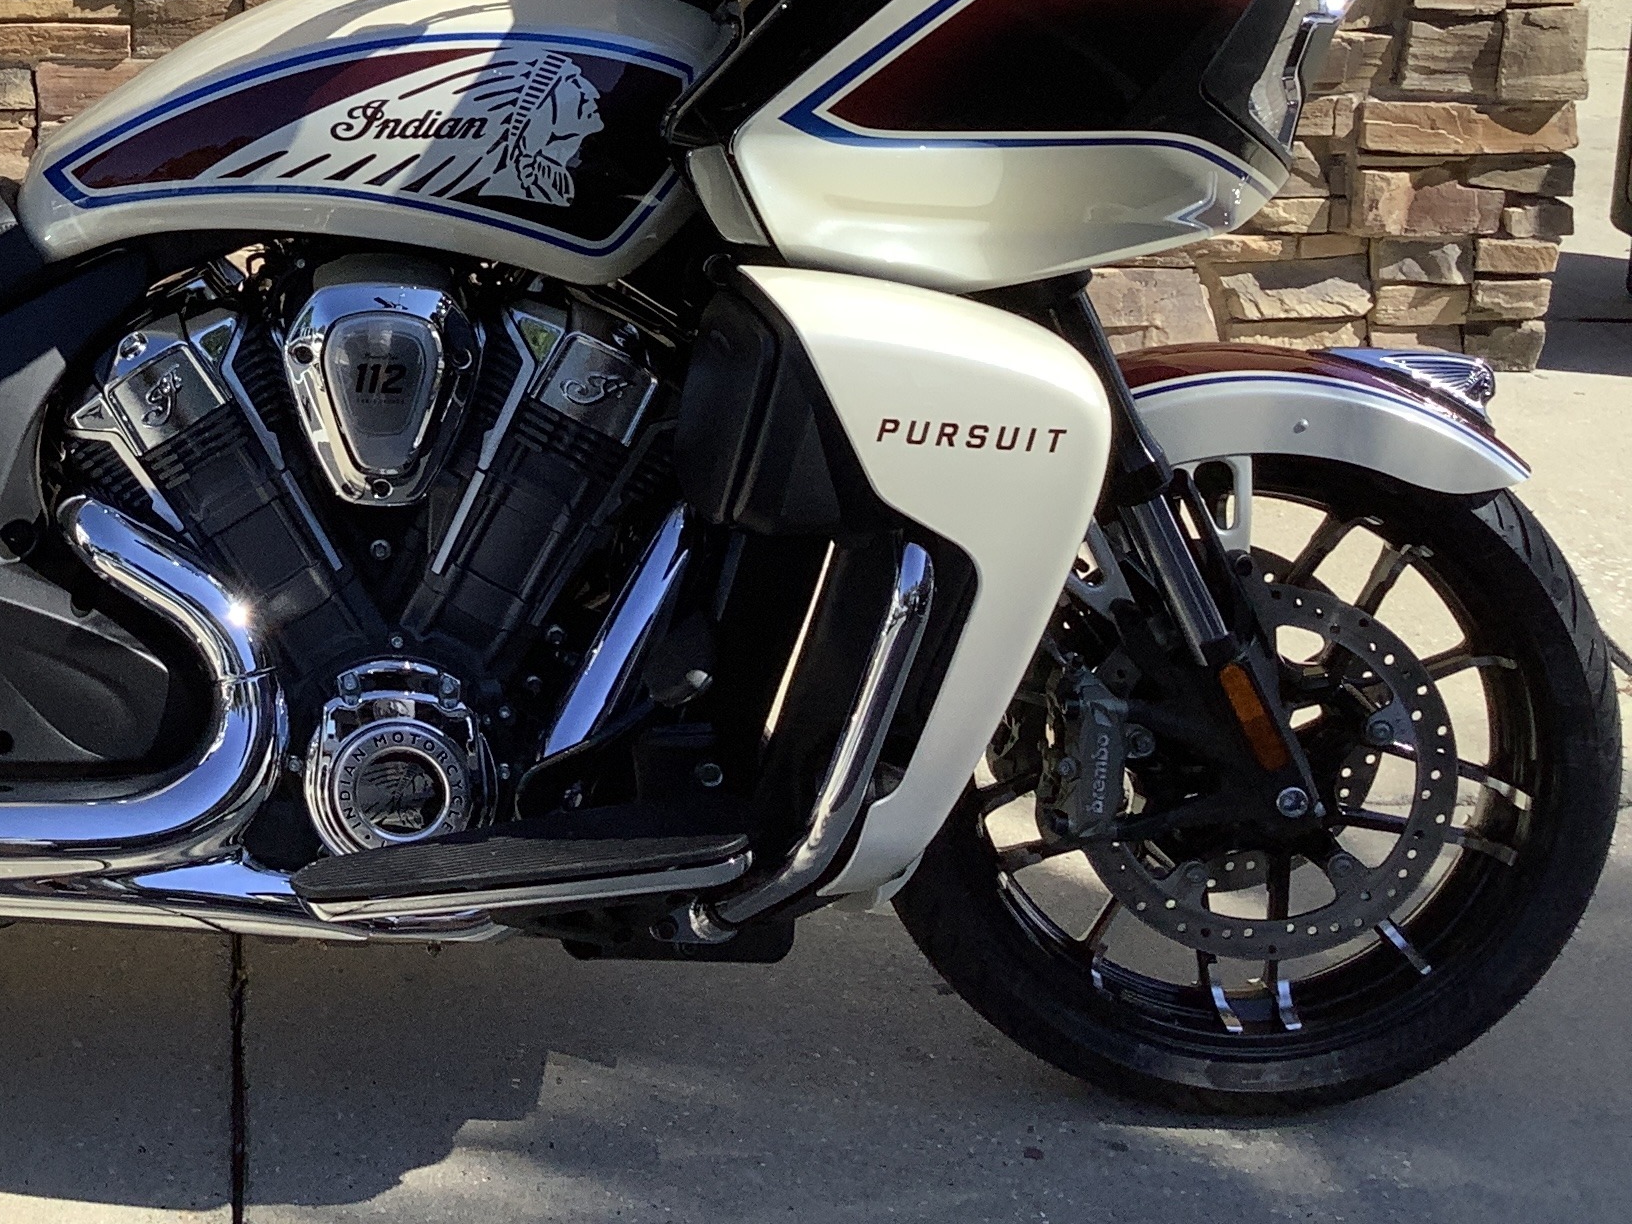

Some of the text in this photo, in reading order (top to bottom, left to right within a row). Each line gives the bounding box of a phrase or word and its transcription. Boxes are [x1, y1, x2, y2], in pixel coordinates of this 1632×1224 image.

[330, 98, 489, 141] Indian
[355, 363, 407, 394] 112
[876, 418, 1068, 453] PURSUIT
[339, 731, 464, 833] INDIAN MOTORCYCLE
[1086, 734, 1110, 814] brembo
